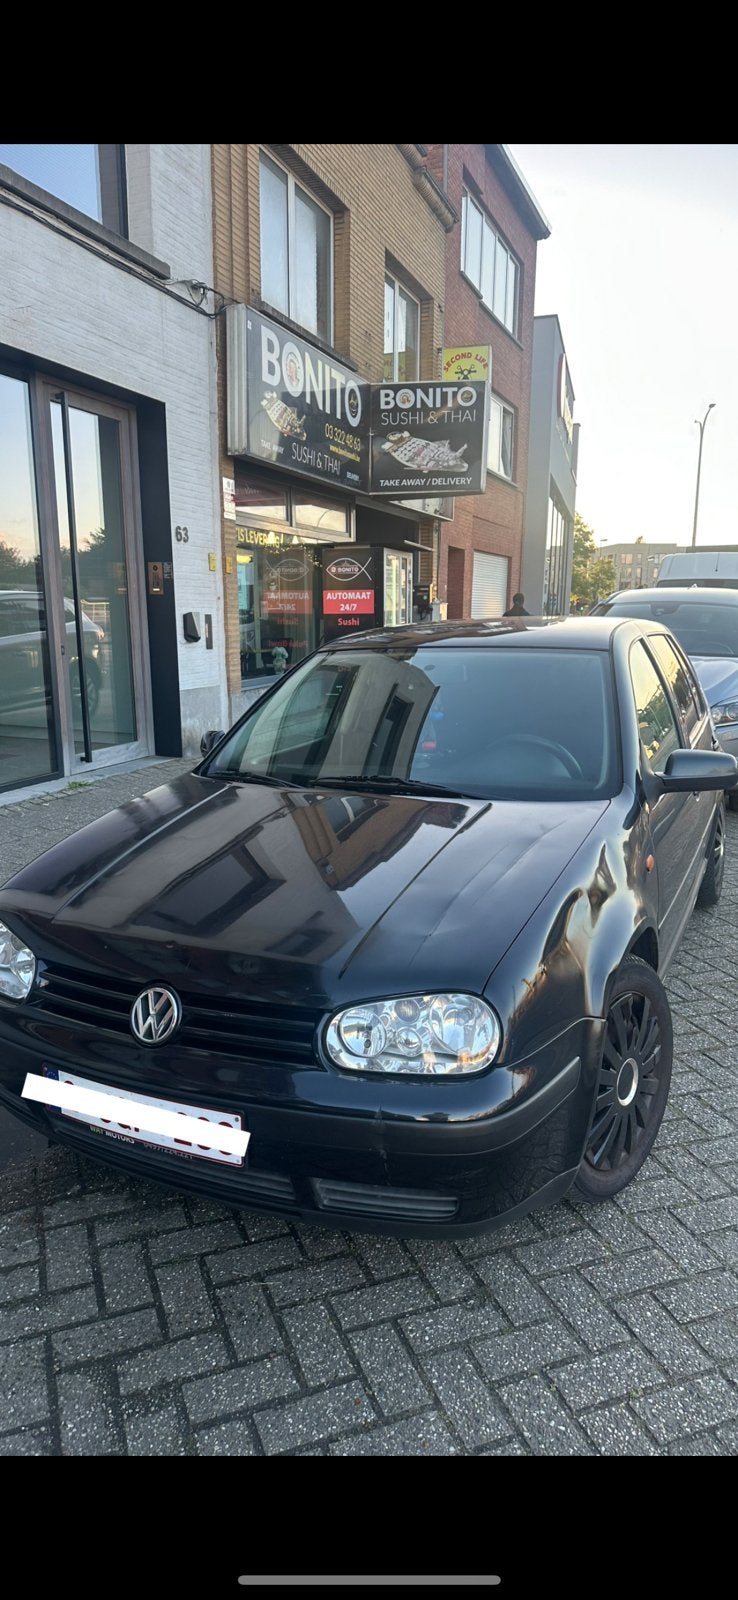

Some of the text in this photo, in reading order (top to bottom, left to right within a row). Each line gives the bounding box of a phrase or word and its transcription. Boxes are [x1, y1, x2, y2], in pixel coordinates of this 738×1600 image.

[443, 351, 489, 372] SECOND LIFE
[261, 324, 362, 427] BONITO
[380, 386, 477, 410] BONITO
[381, 409, 476, 426] SUSHI & THAI
[324, 422, 334, 440] 03
[291, 442, 316, 468] SUSHI
[323, 454, 341, 475] THAI
[380, 479, 400, 487] TAKE
[400, 478, 426, 486] AWAY
[432, 477, 472, 486] DELIVERY
[175, 525, 189, 543] 63
[326, 592, 371, 600] AUTOMAAT
[340, 603, 358, 612] 24/7
[337, 618, 360, 626] Sushi
